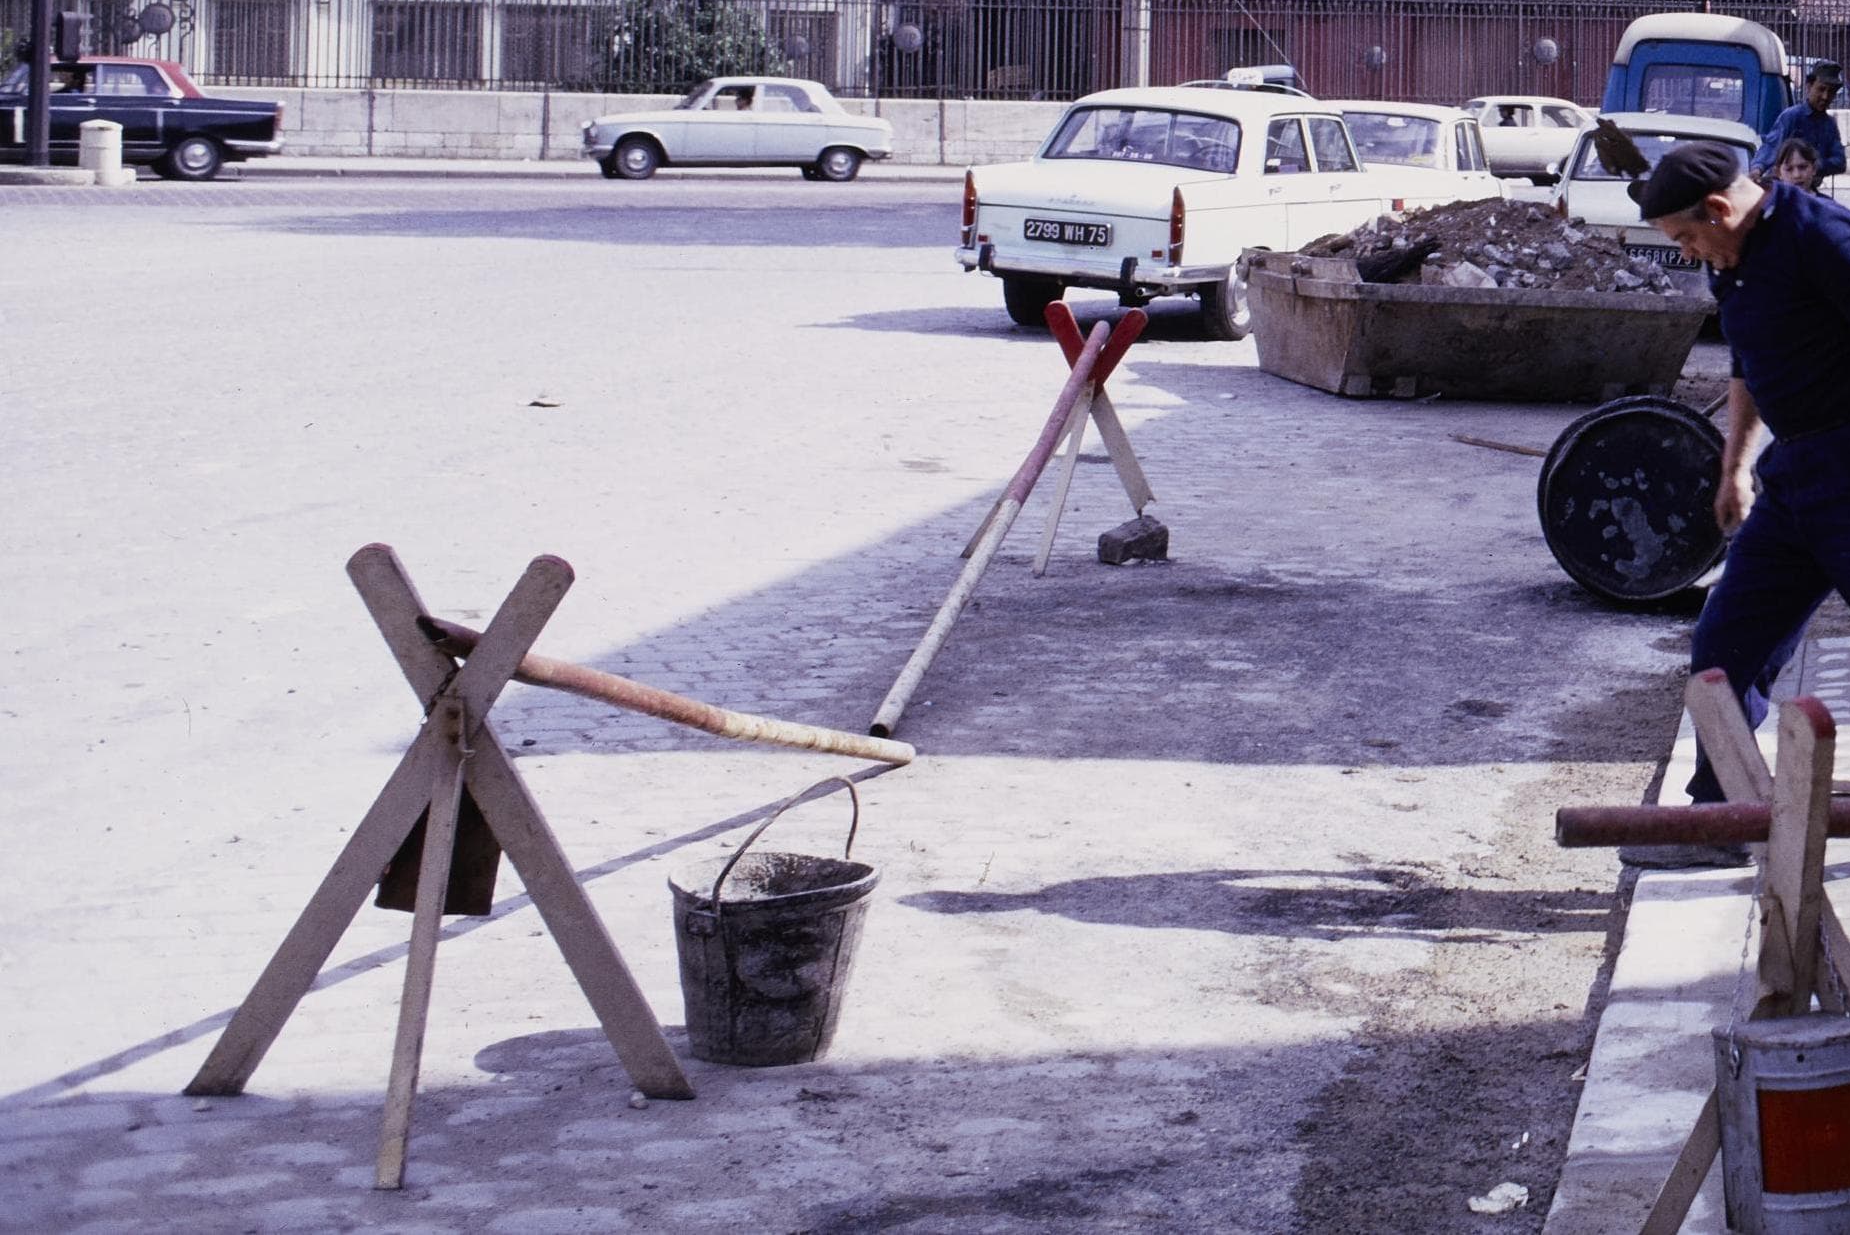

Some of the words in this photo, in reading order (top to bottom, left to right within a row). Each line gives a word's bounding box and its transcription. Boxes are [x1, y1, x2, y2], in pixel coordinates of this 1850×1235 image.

[1026, 220, 1060, 240] 2799
[1064, 223, 1084, 242] WH
[1088, 225, 1107, 244] 75
